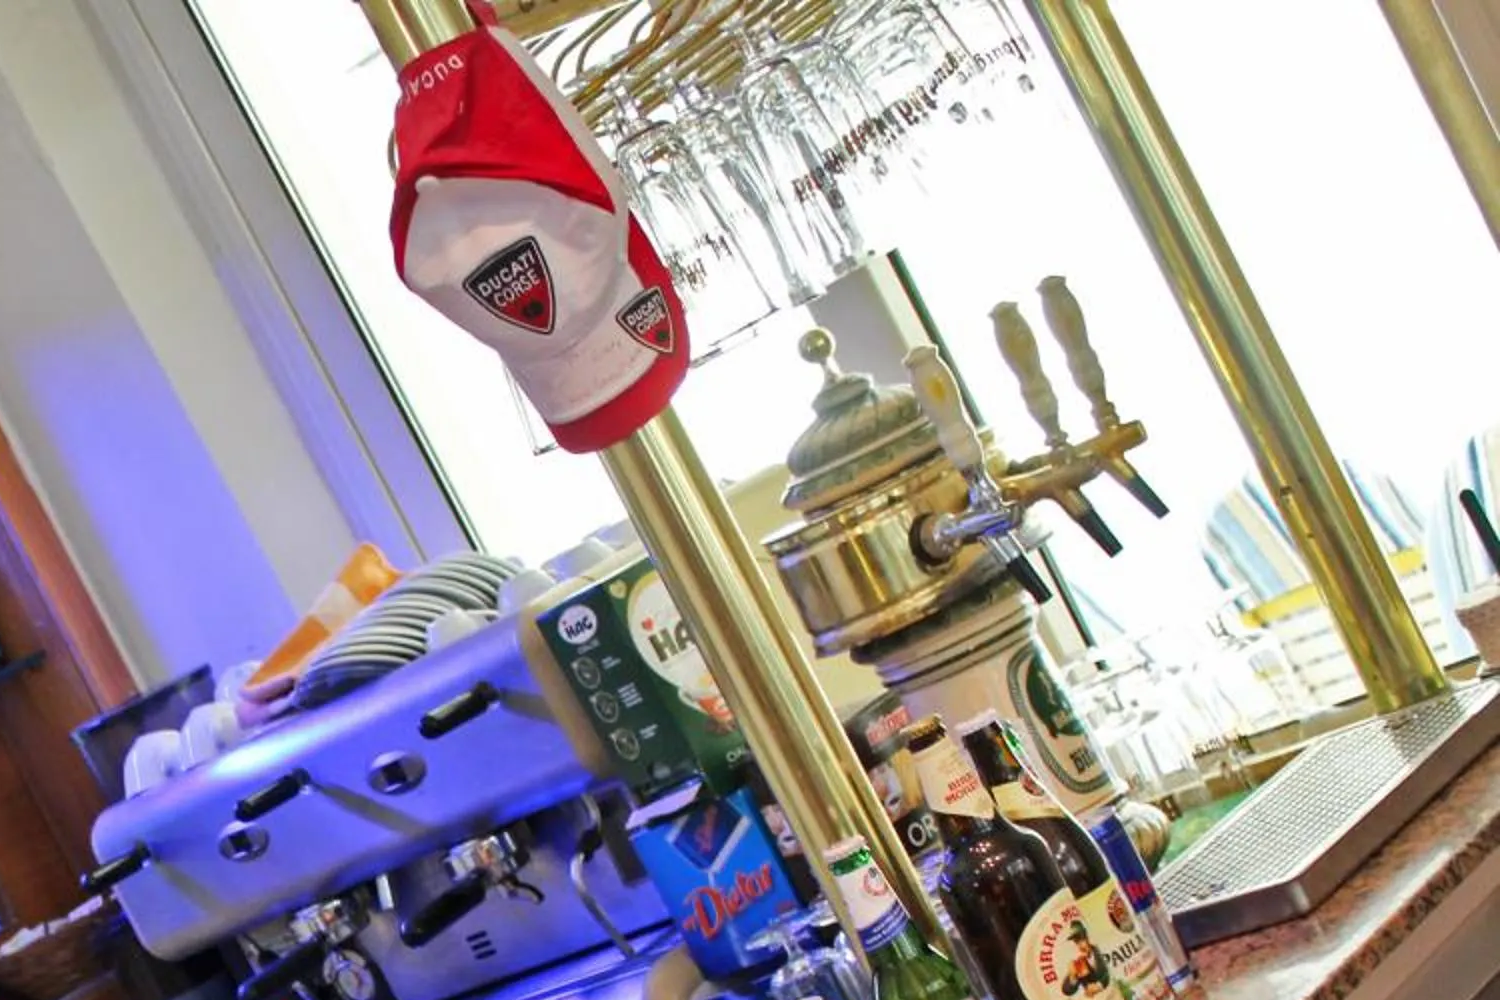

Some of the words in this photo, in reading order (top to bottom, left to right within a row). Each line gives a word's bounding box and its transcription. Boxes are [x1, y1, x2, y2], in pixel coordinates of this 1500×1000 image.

[401, 53, 465, 104] DUCA
[478, 250, 536, 297] DUCATI
[493, 269, 541, 308] CORSE
[626, 295, 662, 327] DUCATI
[648, 618, 691, 662] HA
[907, 812, 939, 847] OR
[1039, 919, 1063, 985] BIRRA
